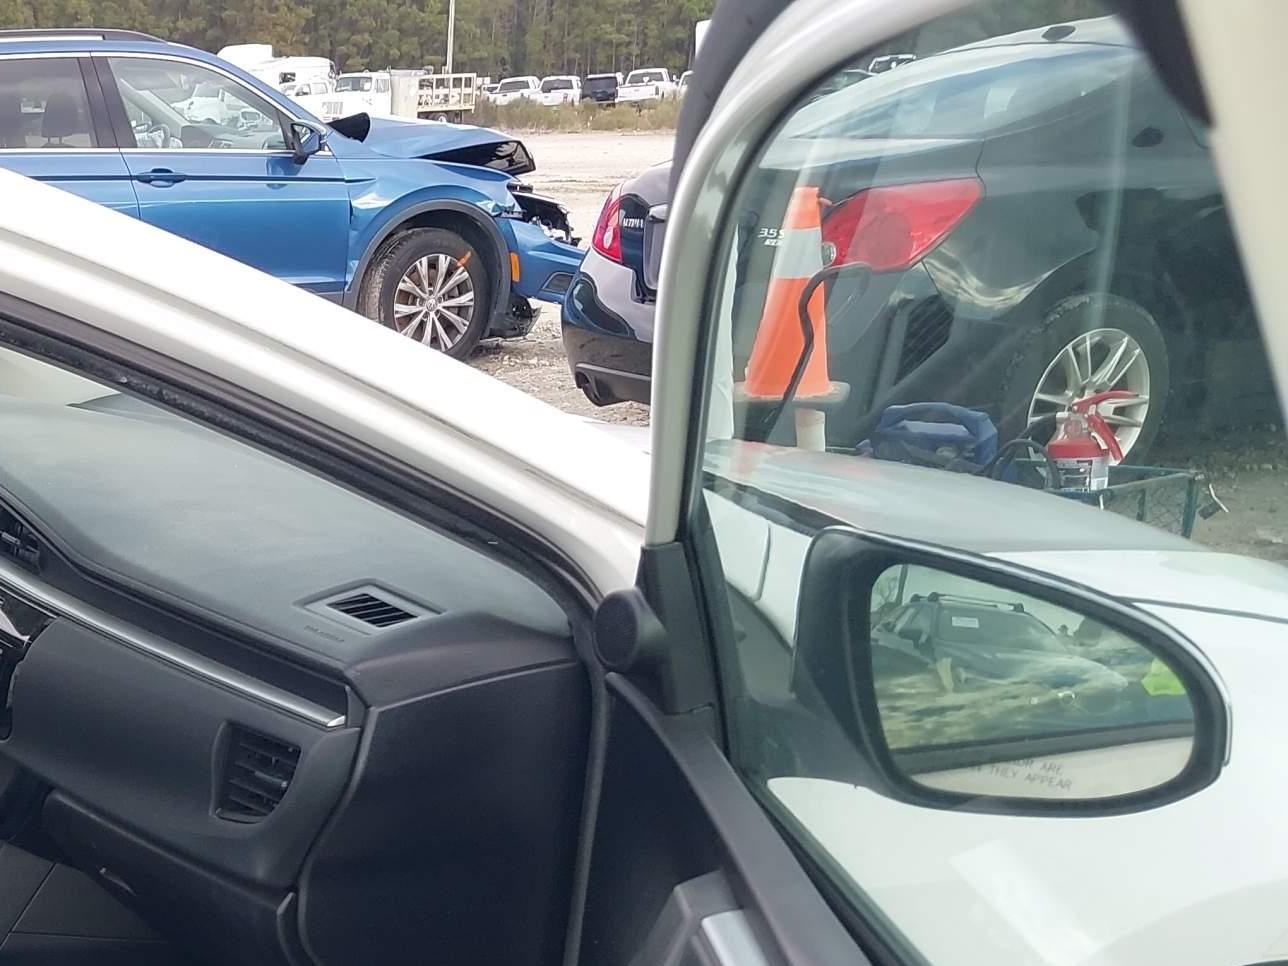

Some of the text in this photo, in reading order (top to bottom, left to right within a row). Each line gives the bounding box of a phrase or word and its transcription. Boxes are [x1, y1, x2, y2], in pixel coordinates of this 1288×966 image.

[990, 765, 1019, 779] THEY
[1024, 773, 1072, 791] APPEAR
[1040, 761, 1064, 776] ARE
